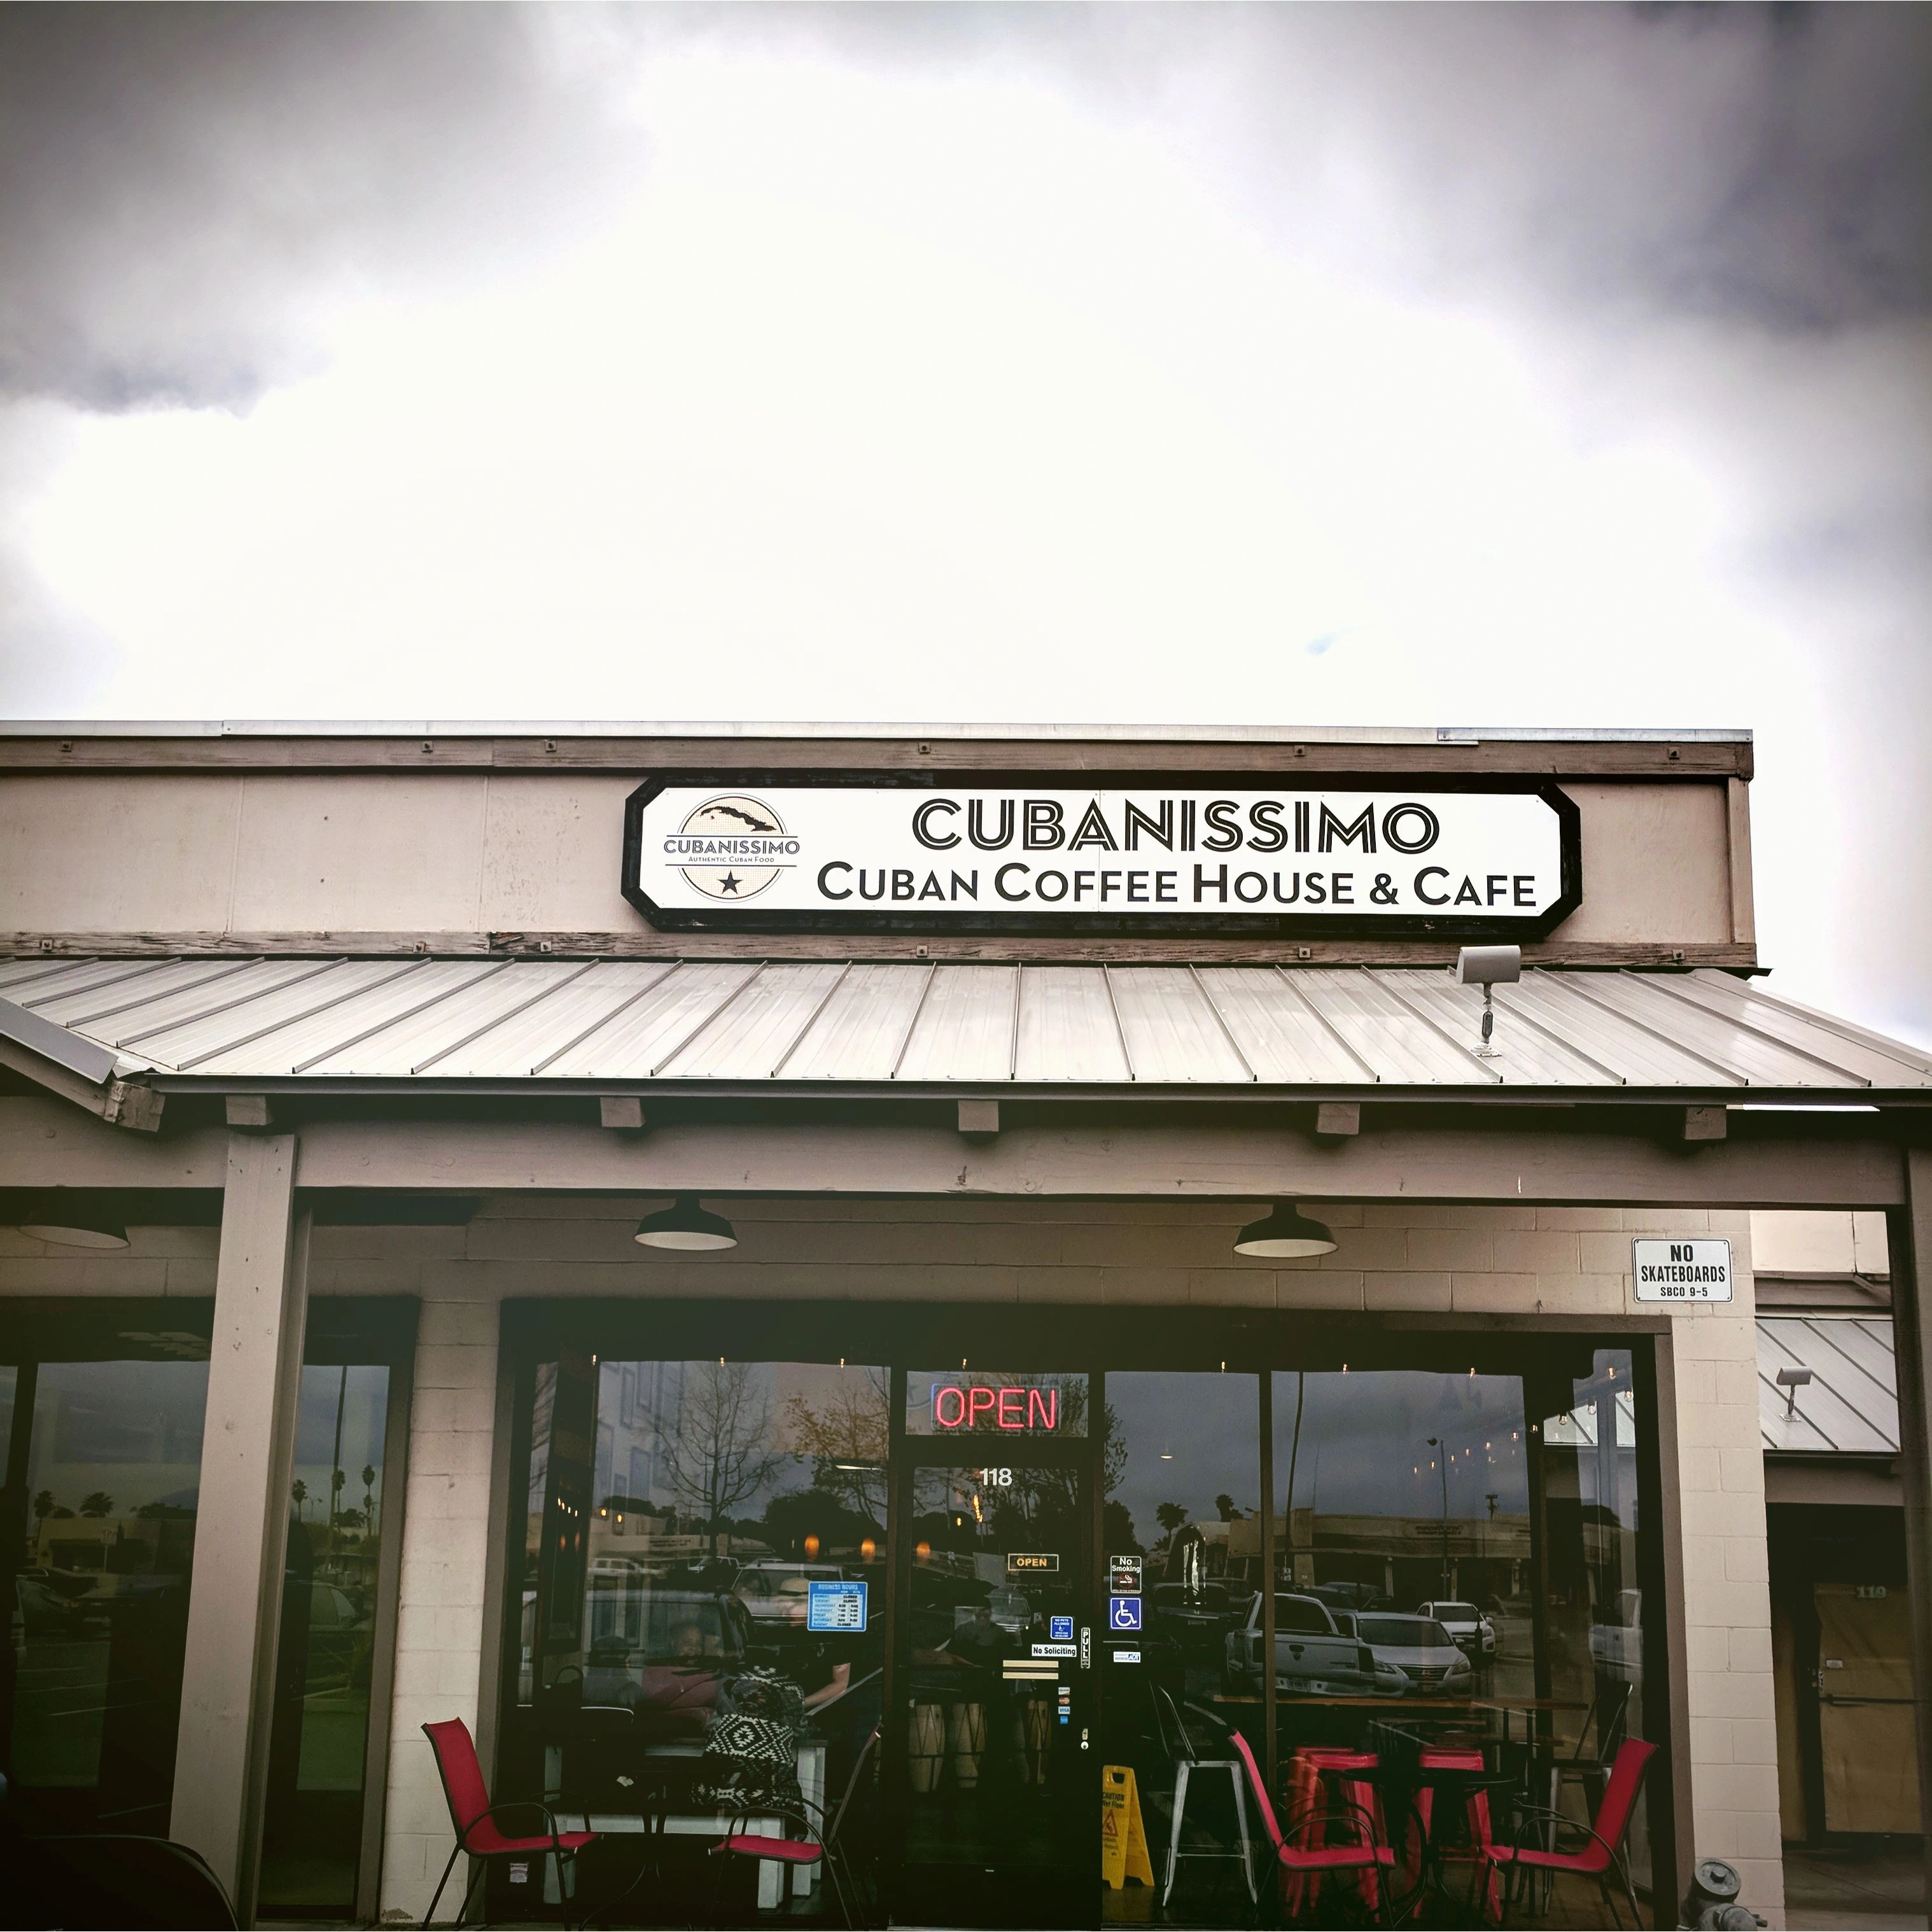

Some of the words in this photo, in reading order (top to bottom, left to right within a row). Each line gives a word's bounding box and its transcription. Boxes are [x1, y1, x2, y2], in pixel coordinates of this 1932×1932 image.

[912, 797, 1439, 855] CUBANISSIMO
[664, 839, 800, 854] CUBANISSIMO
[1369, 873, 1399, 906] &
[1670, 1245, 1693, 1262] NO
[1641, 1265, 1726, 1283] SKATEBOARDS
[1690, 1287, 1708, 1297] 9-5
[935, 1386, 1056, 1429] OPEN
[979, 1467, 1013, 1486] 118
[1016, 1558, 1047, 1567] OPEN
[1112, 1565, 1140, 1573] Smoking
[1119, 1557, 1132, 1565] No
[1044, 1647, 1076, 1656] Soliciting
